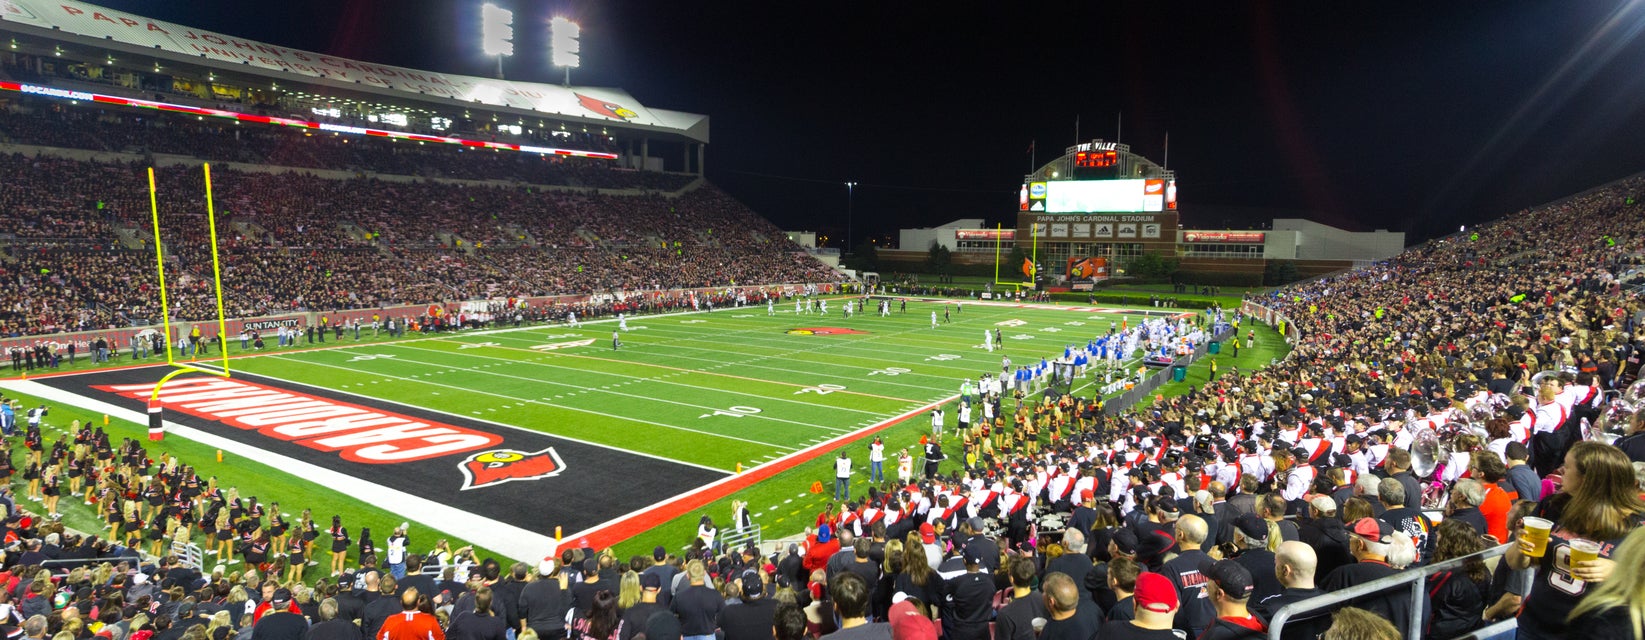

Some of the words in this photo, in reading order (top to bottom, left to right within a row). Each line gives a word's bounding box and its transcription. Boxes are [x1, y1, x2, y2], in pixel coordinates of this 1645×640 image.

[61, 4, 171, 35] PAPA
[184, 30, 312, 62] JOHN'S
[190, 43, 348, 79] UNIVERSITY
[364, 75, 394, 86] OF
[1077, 142, 1092, 152] THE
[1094, 142, 1117, 151] VILLE
[245, 322, 262, 331] SUN
[262, 320, 280, 329] TAN
[801, 383, 847, 395] 20
[712, 405, 763, 418] 10
[90, 376, 504, 463] CARDINALS
